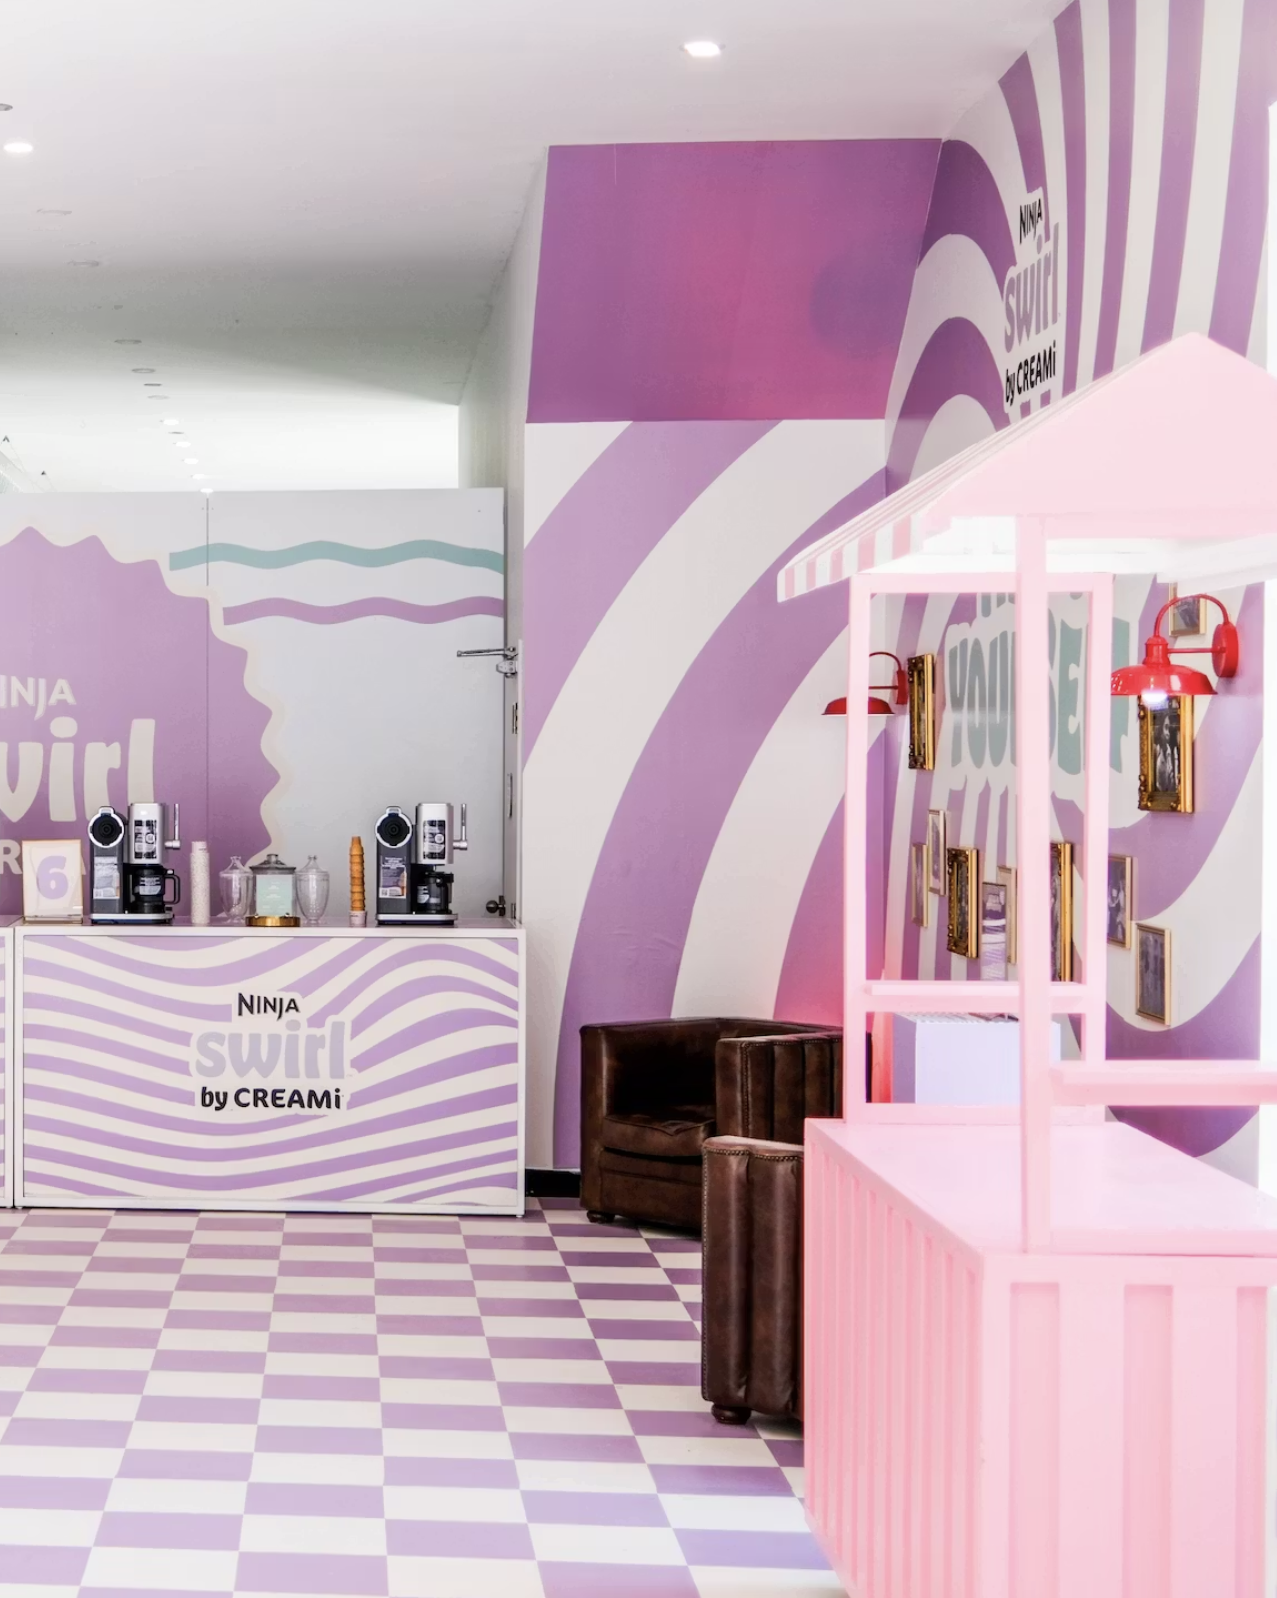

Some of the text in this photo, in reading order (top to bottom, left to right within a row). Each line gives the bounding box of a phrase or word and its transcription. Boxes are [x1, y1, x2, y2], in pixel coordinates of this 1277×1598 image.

[1019, 198, 1043, 245] NINJA
[1004, 222, 1059, 354] swirl
[1005, 340, 1056, 406] by CREAMi
[37, 855, 68, 900] 6
[237, 992, 300, 1021] NINJA
[195, 1019, 345, 1079] swirl
[201, 1086, 341, 1111] by CREAMi
